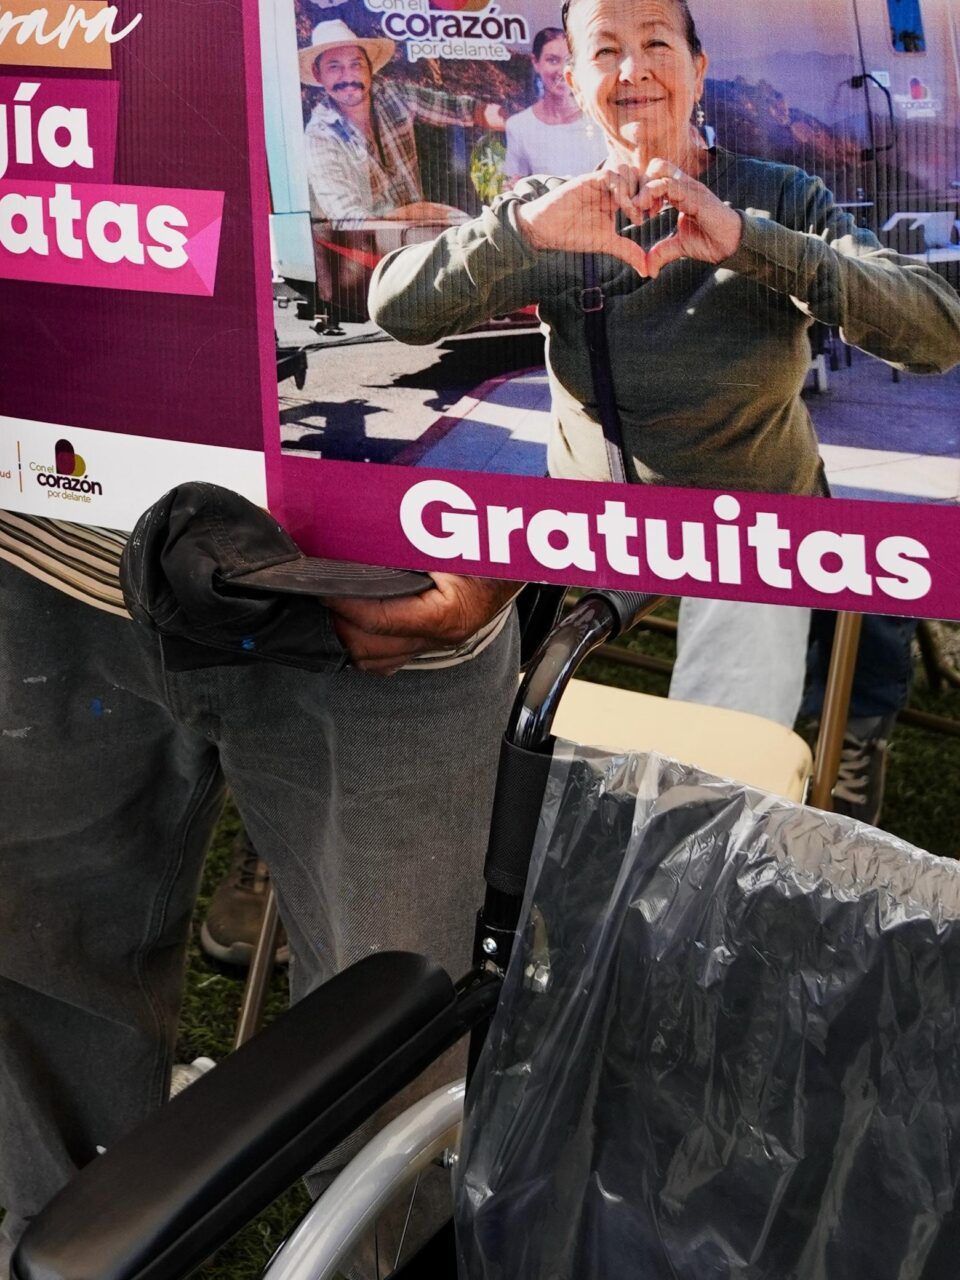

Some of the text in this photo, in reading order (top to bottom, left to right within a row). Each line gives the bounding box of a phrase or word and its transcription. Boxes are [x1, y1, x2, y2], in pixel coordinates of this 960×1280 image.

[384, 8, 527, 40] corazón
[411, 42, 439, 57] por
[29, 461, 46, 473] Con
[37, 472, 103, 496] corazón
[48, 490, 61, 500] por
[399, 479, 933, 601] Gratuitas
